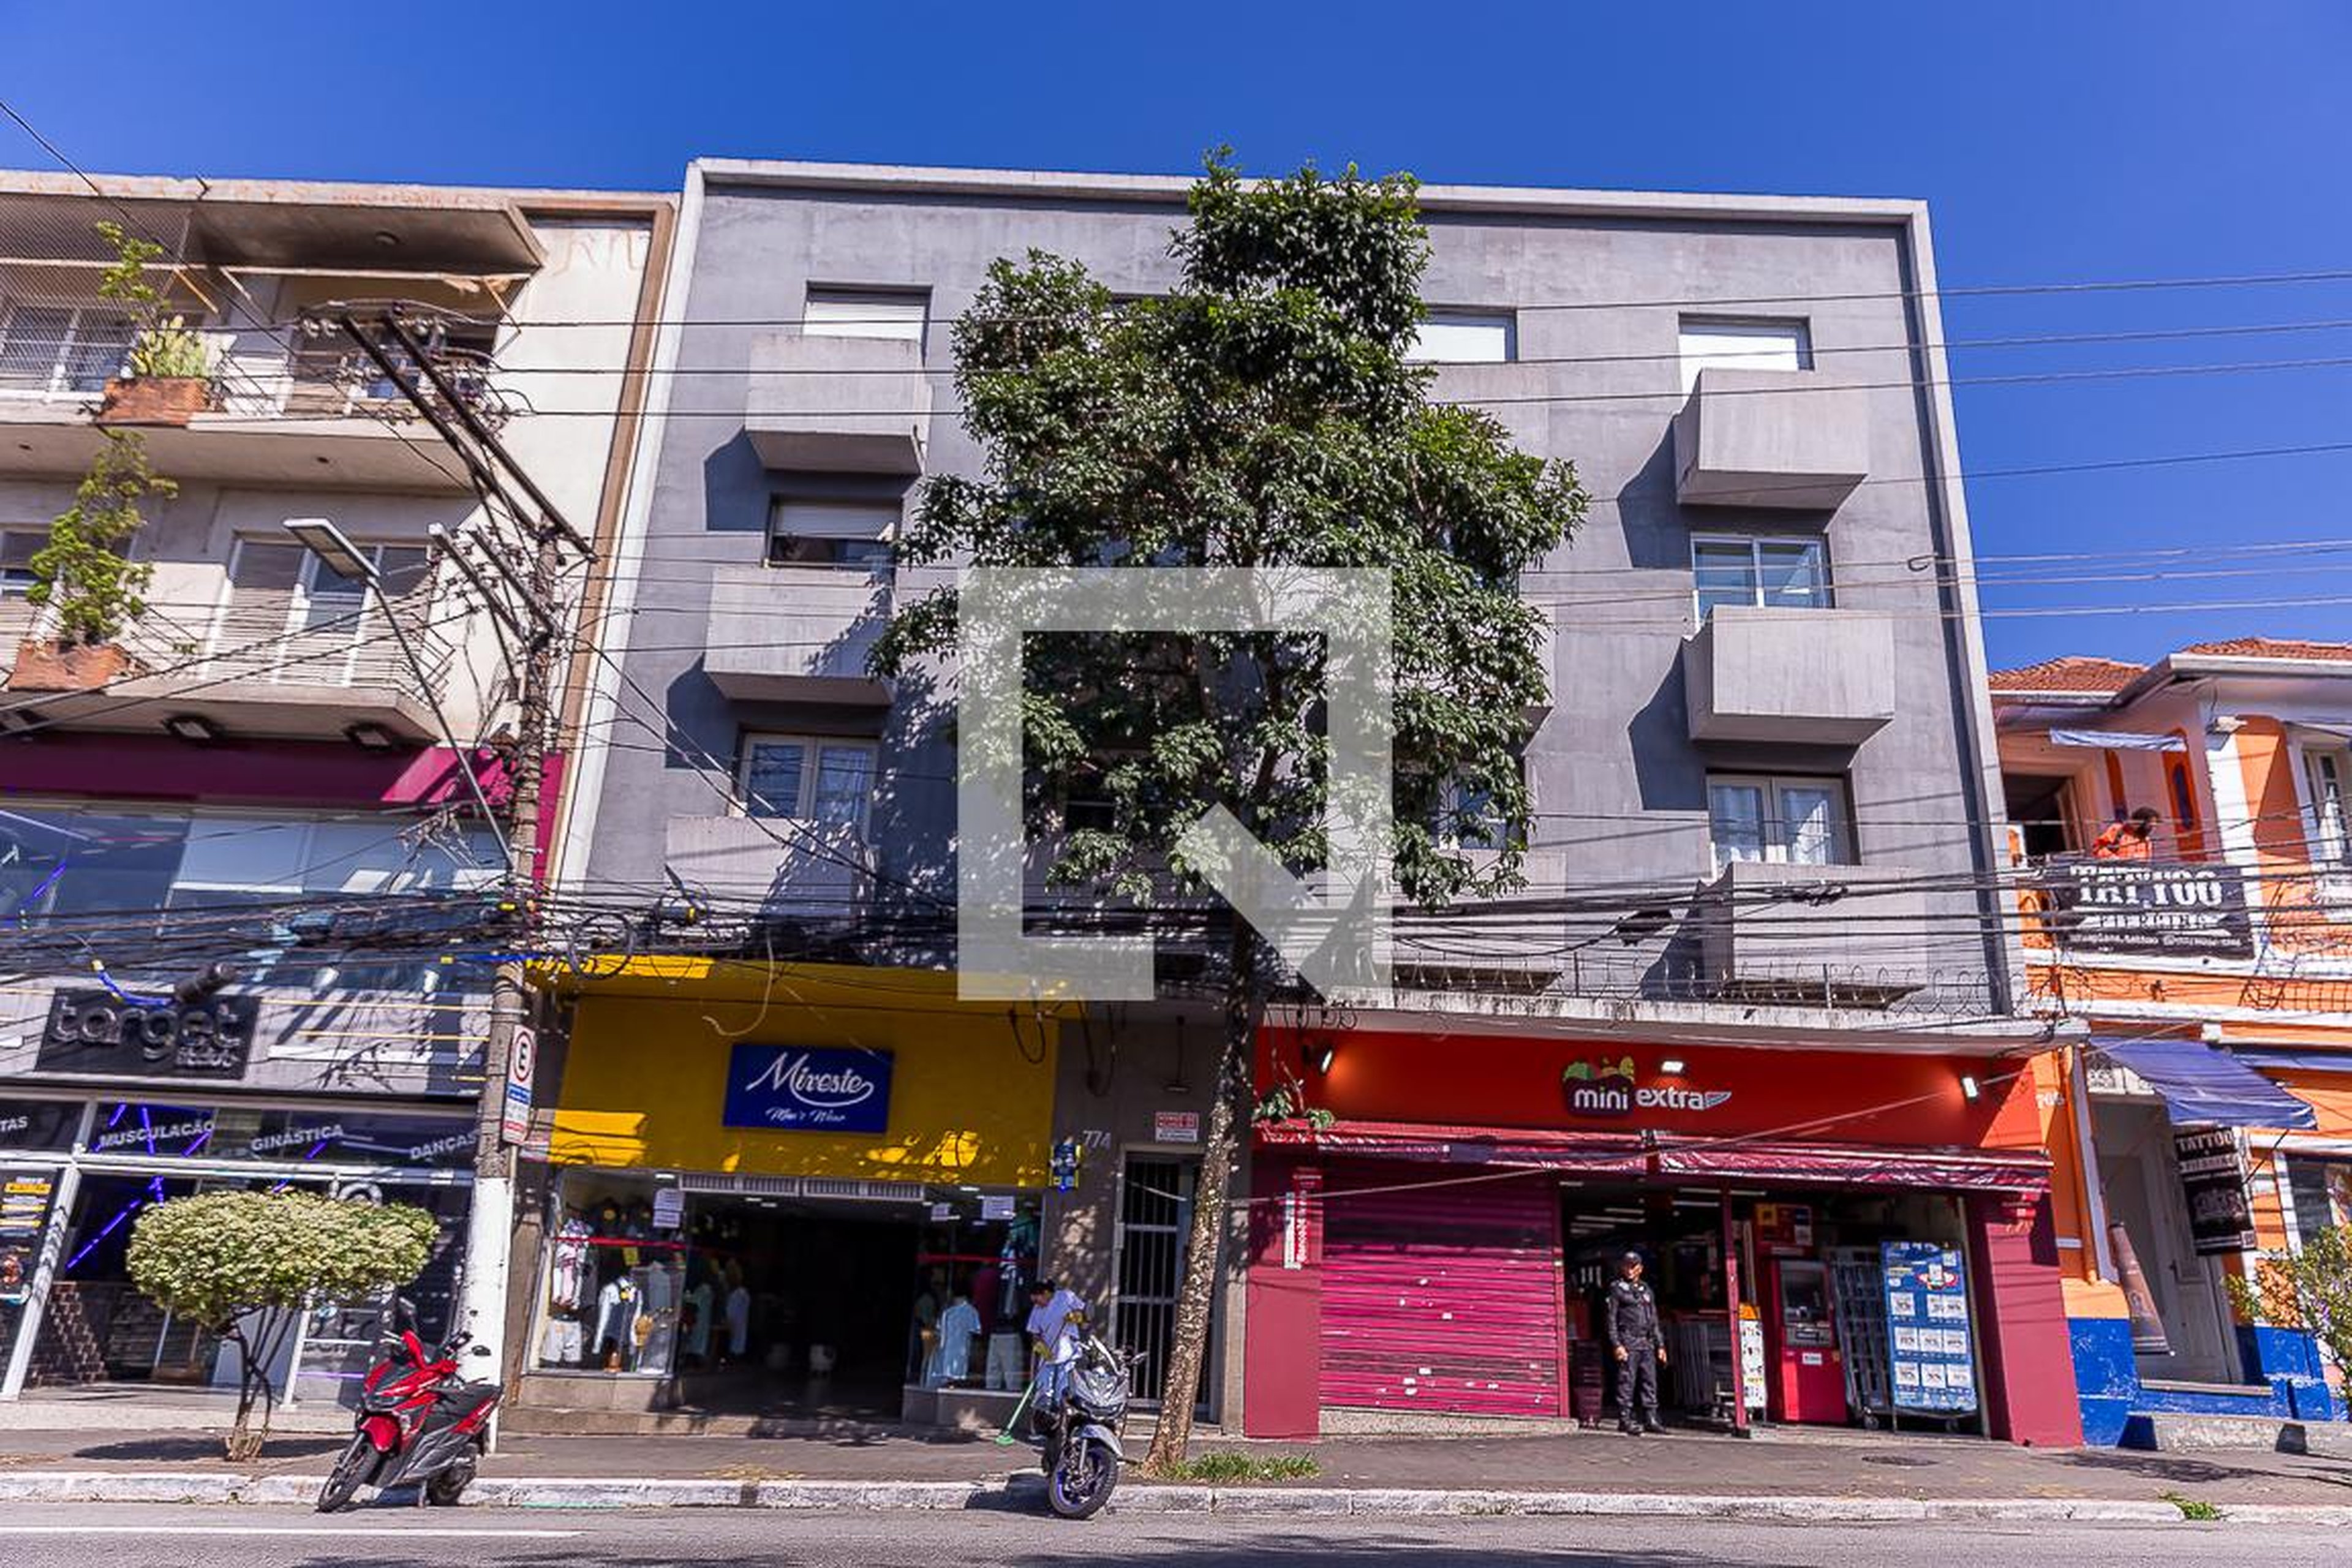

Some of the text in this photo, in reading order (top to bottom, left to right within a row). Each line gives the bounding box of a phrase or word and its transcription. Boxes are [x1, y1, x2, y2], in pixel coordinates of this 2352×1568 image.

[745, 1052, 875, 1107] Mireste
[1574, 1085, 1706, 1110] mini extra
[1082, 1129, 1111, 1150] 774
[2176, 1129, 2235, 1153] TATTOO
